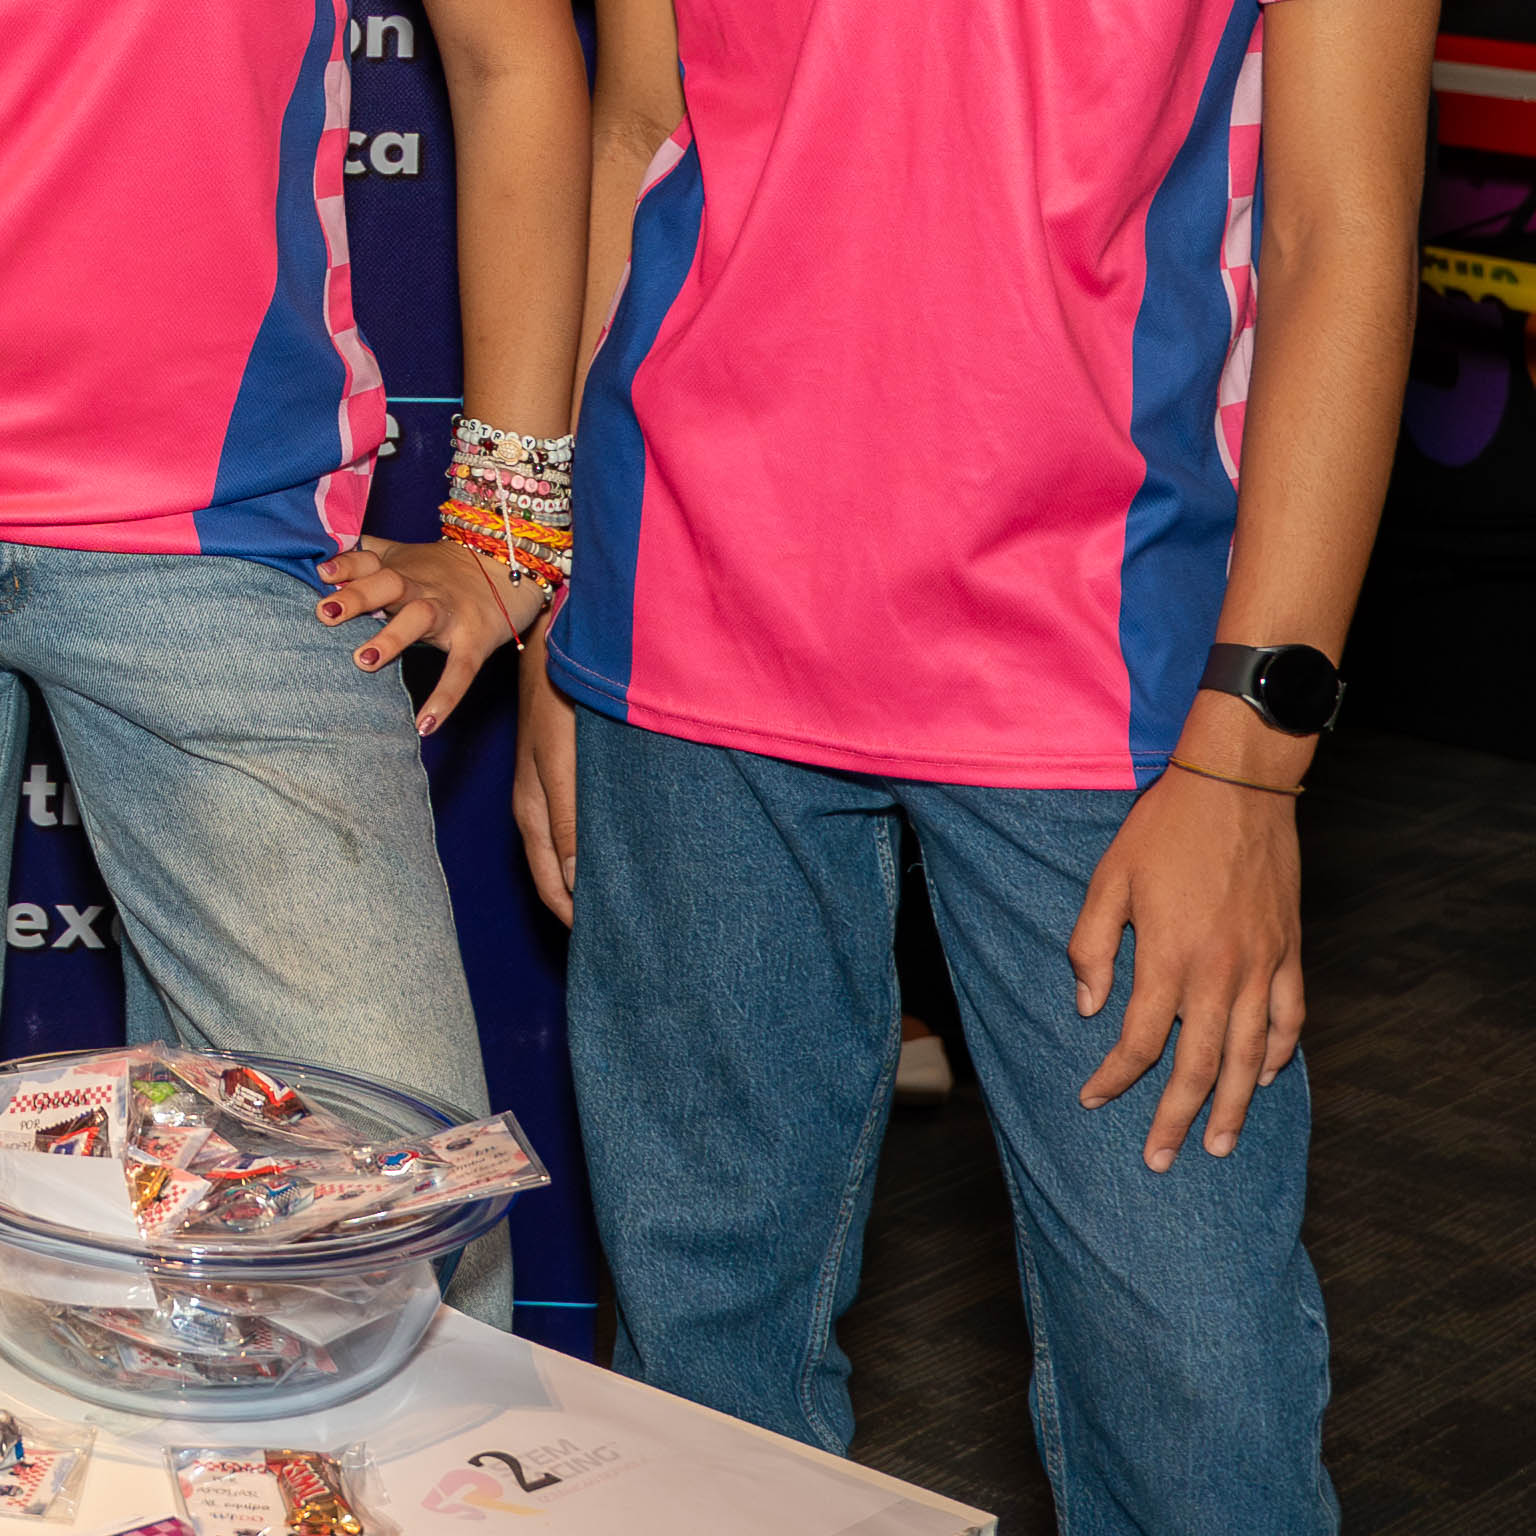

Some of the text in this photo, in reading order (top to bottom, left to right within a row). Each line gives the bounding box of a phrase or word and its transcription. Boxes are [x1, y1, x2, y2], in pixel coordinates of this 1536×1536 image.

[468, 418, 536, 451] STRY
[4, 906, 124, 950] ex
[20, 1119, 41, 1130] POR
